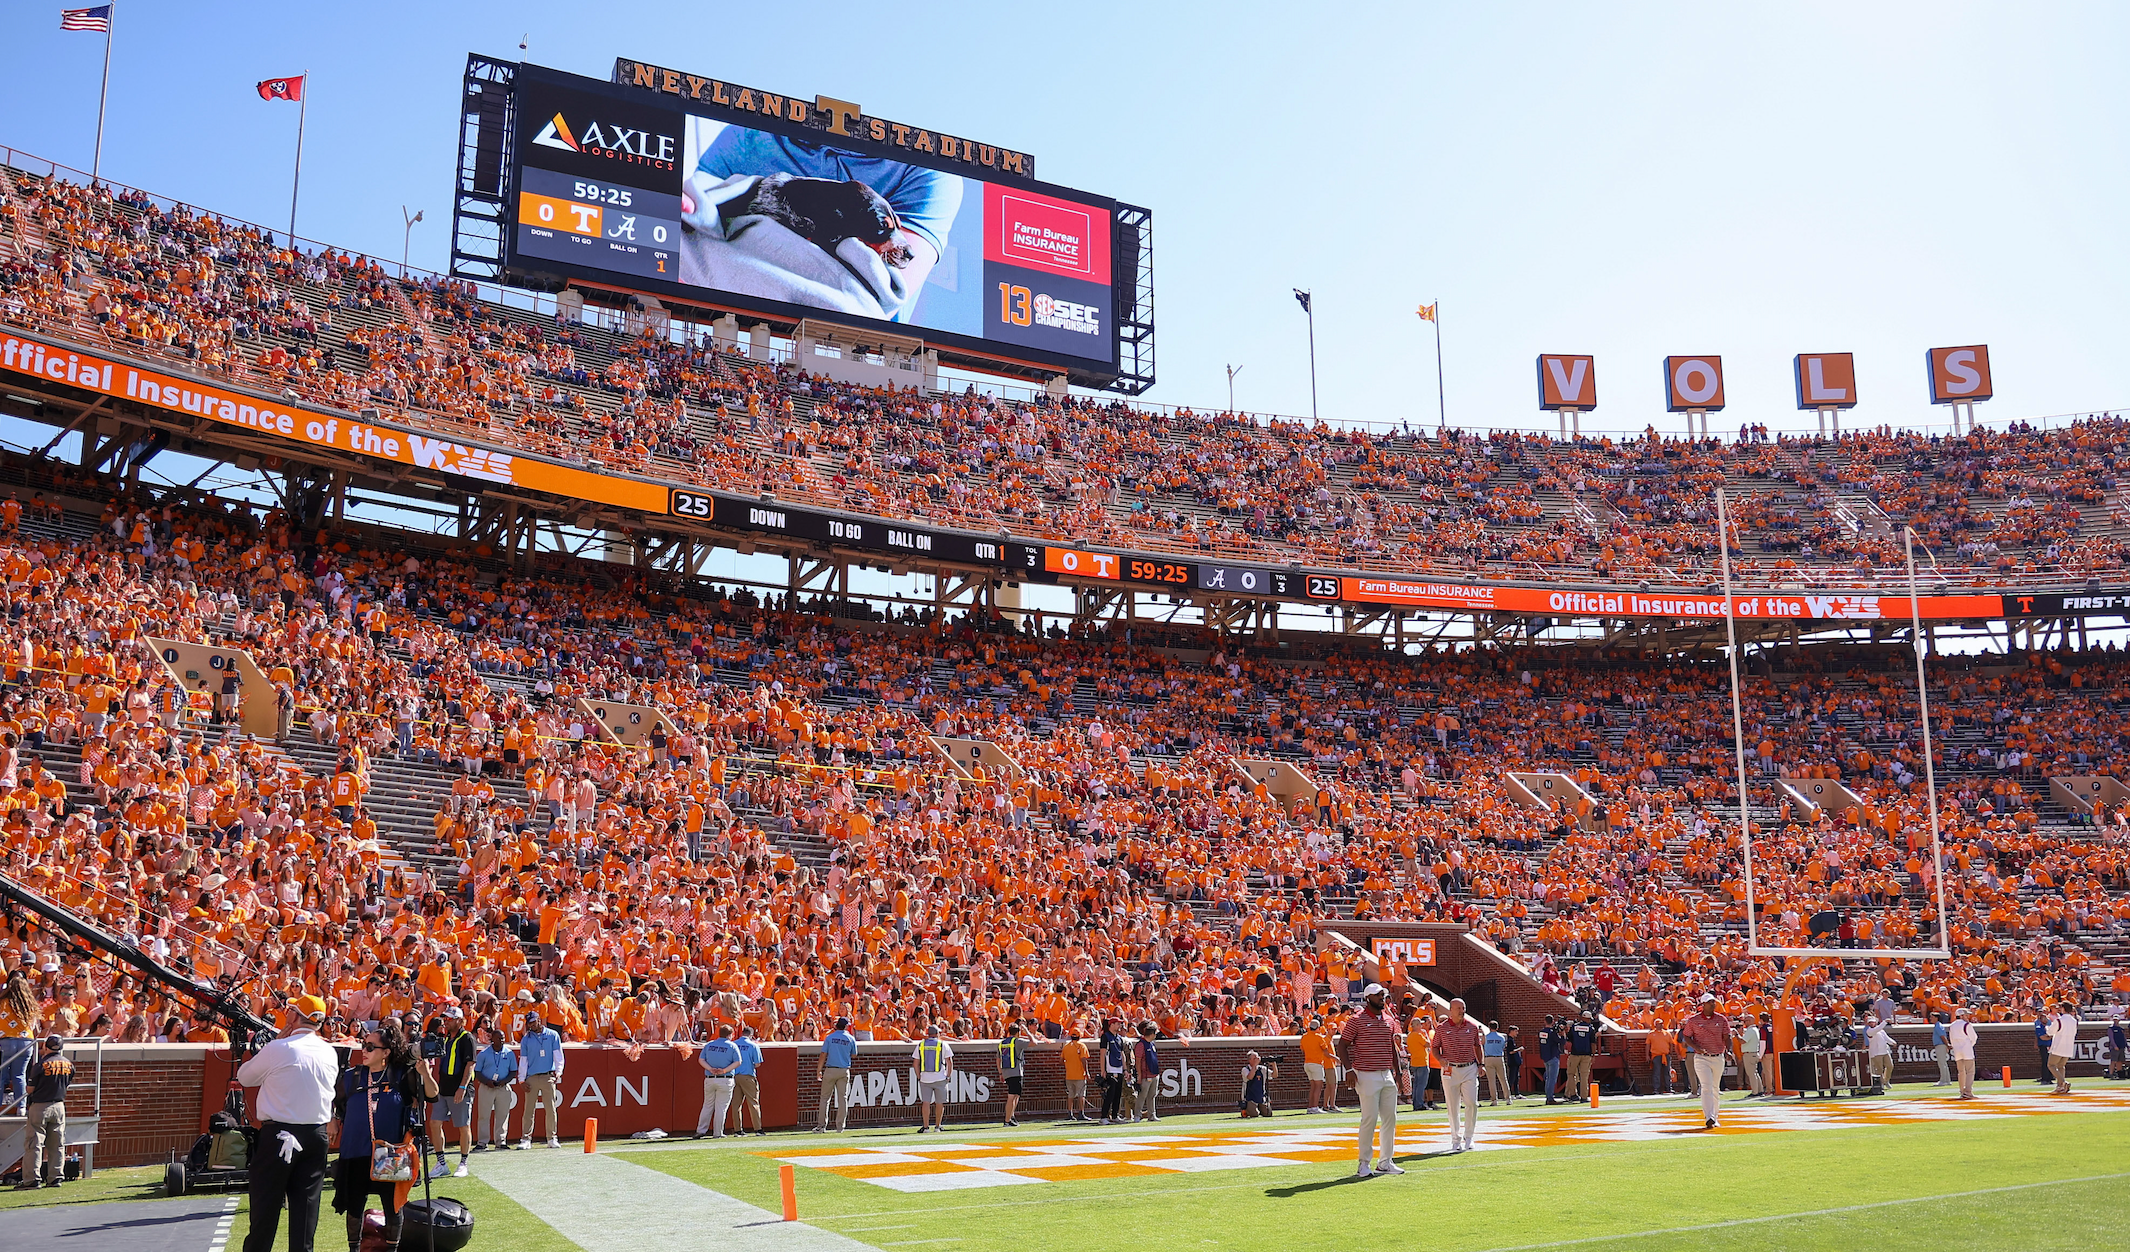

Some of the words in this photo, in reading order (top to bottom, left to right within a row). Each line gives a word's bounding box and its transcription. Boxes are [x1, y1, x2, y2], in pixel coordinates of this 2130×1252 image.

[632, 62, 807, 122] NEYLAND
[869, 118, 1024, 174] STADIUM
[581, 120, 675, 163] AXLE
[581, 145, 674, 171] LOGISTICS
[573, 181, 633, 207] 59:25
[538, 203, 554, 222] 0
[570, 204, 599, 233] T
[652, 225, 668, 243] 0
[1013, 221, 1042, 236] Farm
[1043, 227, 1079, 244] Bureau
[530, 228, 553, 239] DOWN
[570, 235, 581, 243] TO
[581, 237, 592, 245] GO
[609, 243, 627, 253] BALL
[627, 246, 638, 254] ON
[654, 251, 669, 260] QTR
[1013, 232, 1079, 256] INSURANCE
[656, 260, 667, 273] 1
[1053, 256, 1079, 266] Tennessee
[998, 281, 1032, 328] 13
[1053, 299, 1100, 325] SEC
[1034, 312, 1100, 336] CHAMPIONSHIPS
[0, 338, 113, 391] fficial
[126, 371, 294, 434] Insurance
[305, 419, 339, 444] of
[349, 424, 400, 457] the
[677, 494, 709, 515] 25
[749, 508, 786, 529] DOWN
[828, 521, 844, 538] TO
[845, 523, 862, 540] GO
[888, 530, 914, 549] BALL
[916, 533, 932, 551] ON
[975, 543, 996, 559] QTR
[999, 545, 1005, 561] 1
[1027, 555, 1036, 566] 3
[1062, 552, 1078, 570] 0
[1092, 554, 1114, 577] T
[1131, 561, 1188, 584] 59:25
[1241, 571, 1256, 589] 0
[1274, 574, 1288, 582] TOL
[1277, 582, 1286, 593] 3
[1310, 578, 1337, 596] 25
[1358, 580, 1387, 592] Farm
[1389, 582, 1426, 595] Bureau
[1427, 585, 1494, 599] INSURANCE
[1466, 601, 1494, 609] Tennessee
[1549, 592, 1624, 614] Official
[1631, 595, 1729, 616] Insurance
[1738, 597, 1759, 616] of
[1766, 596, 1801, 616] the
[2016, 596, 2034, 613] T
[213, 657, 221, 668] J
[631, 713, 638, 723] K
[973, 747, 979, 757] L
[1269, 768, 1277, 777] M
[337, 780, 350, 796] 16
[1545, 780, 1552, 788] N
[2093, 782, 2099, 790] P
[581, 836, 594, 850] 98
[308, 896, 316, 908] 5
[782, 997, 797, 1014] 16
[512, 1013, 525, 1031] 16
[1897, 1044, 1955, 1063] fitne
[42, 1060, 73, 1070] EVENT
[44, 1067, 72, 1077] STAFF
[834, 1068, 902, 1108] APA
[904, 1067, 990, 1106] JHNS
